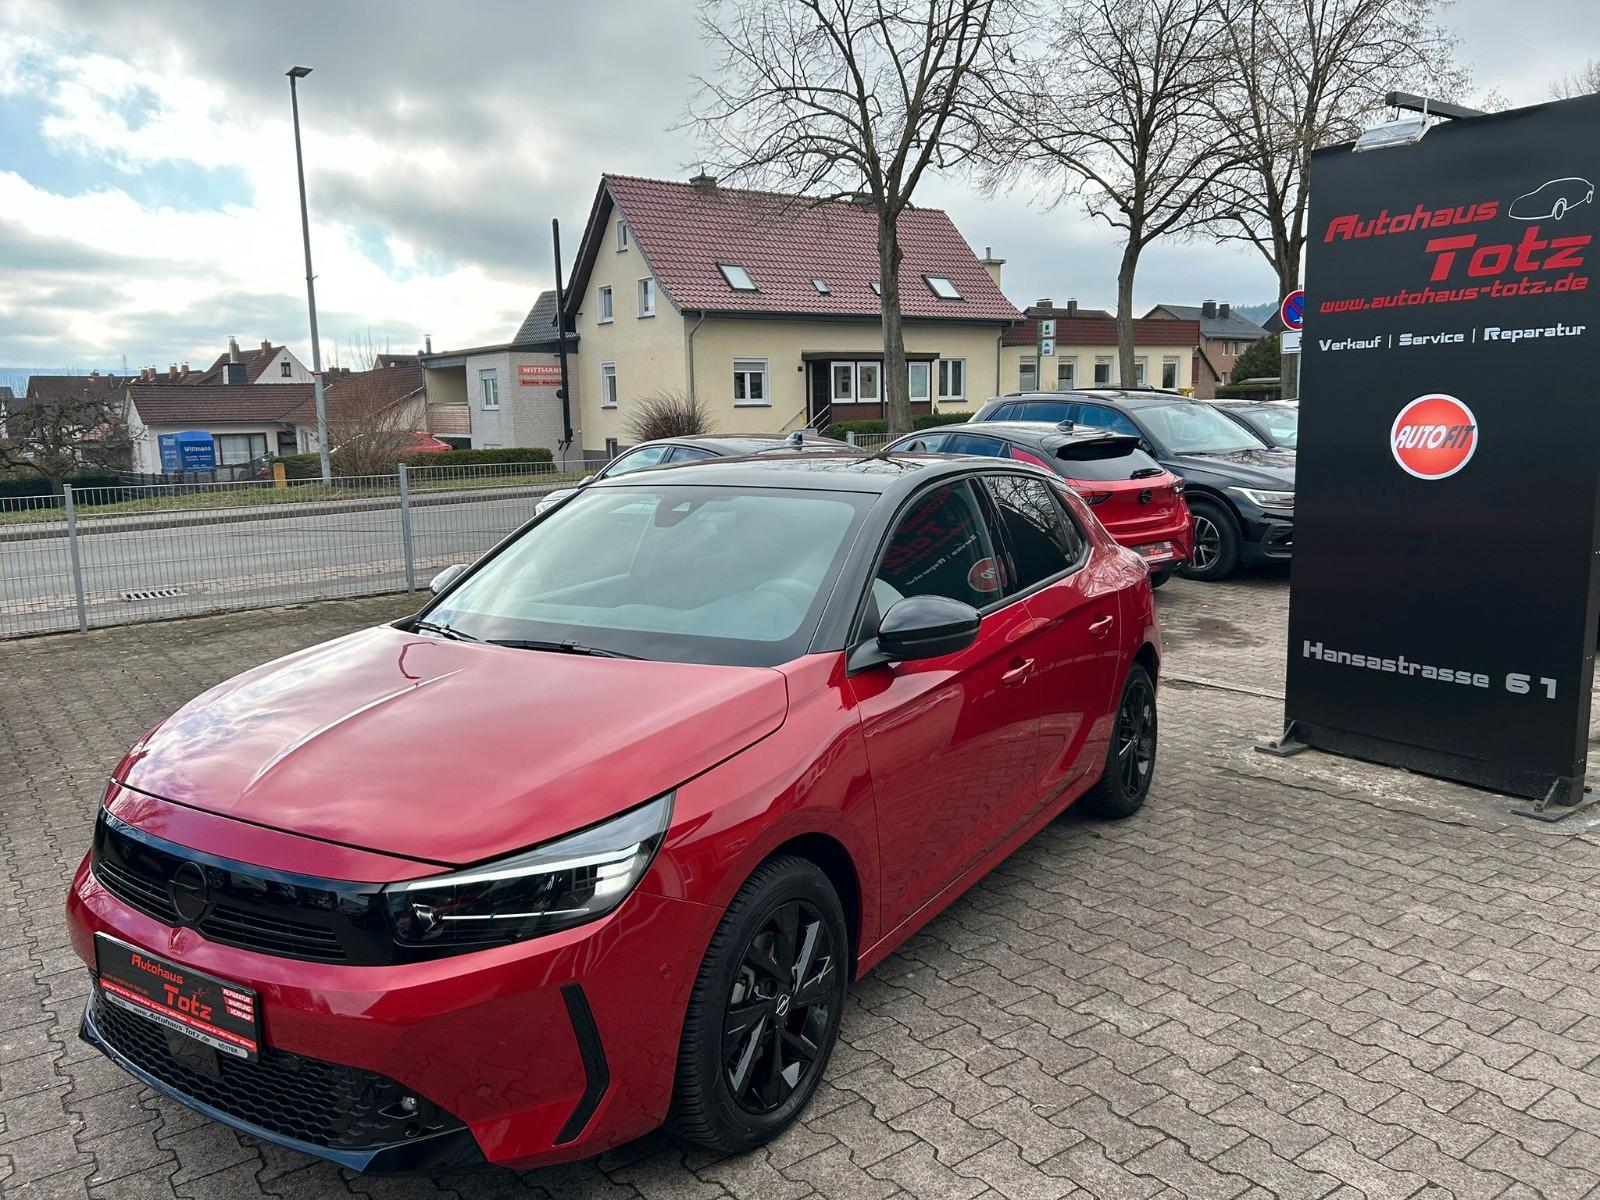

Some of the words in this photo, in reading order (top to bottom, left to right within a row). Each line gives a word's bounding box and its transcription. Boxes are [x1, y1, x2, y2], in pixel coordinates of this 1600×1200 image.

[1323, 201, 1501, 243] Autohaus
[1425, 226, 1592, 281] Totz
[1320, 272, 1589, 313] www.autohaus-totz.de
[1318, 335, 1382, 352] Verkauf
[1398, 332, 1465, 347] Service
[1483, 323, 1587, 342] Reparatur
[1395, 423, 1475, 449] AUTOFIT
[1302, 640, 1490, 688] Hansastrasse
[132, 954, 183, 984] Autohaus
[164, 983, 213, 1020] Totz
